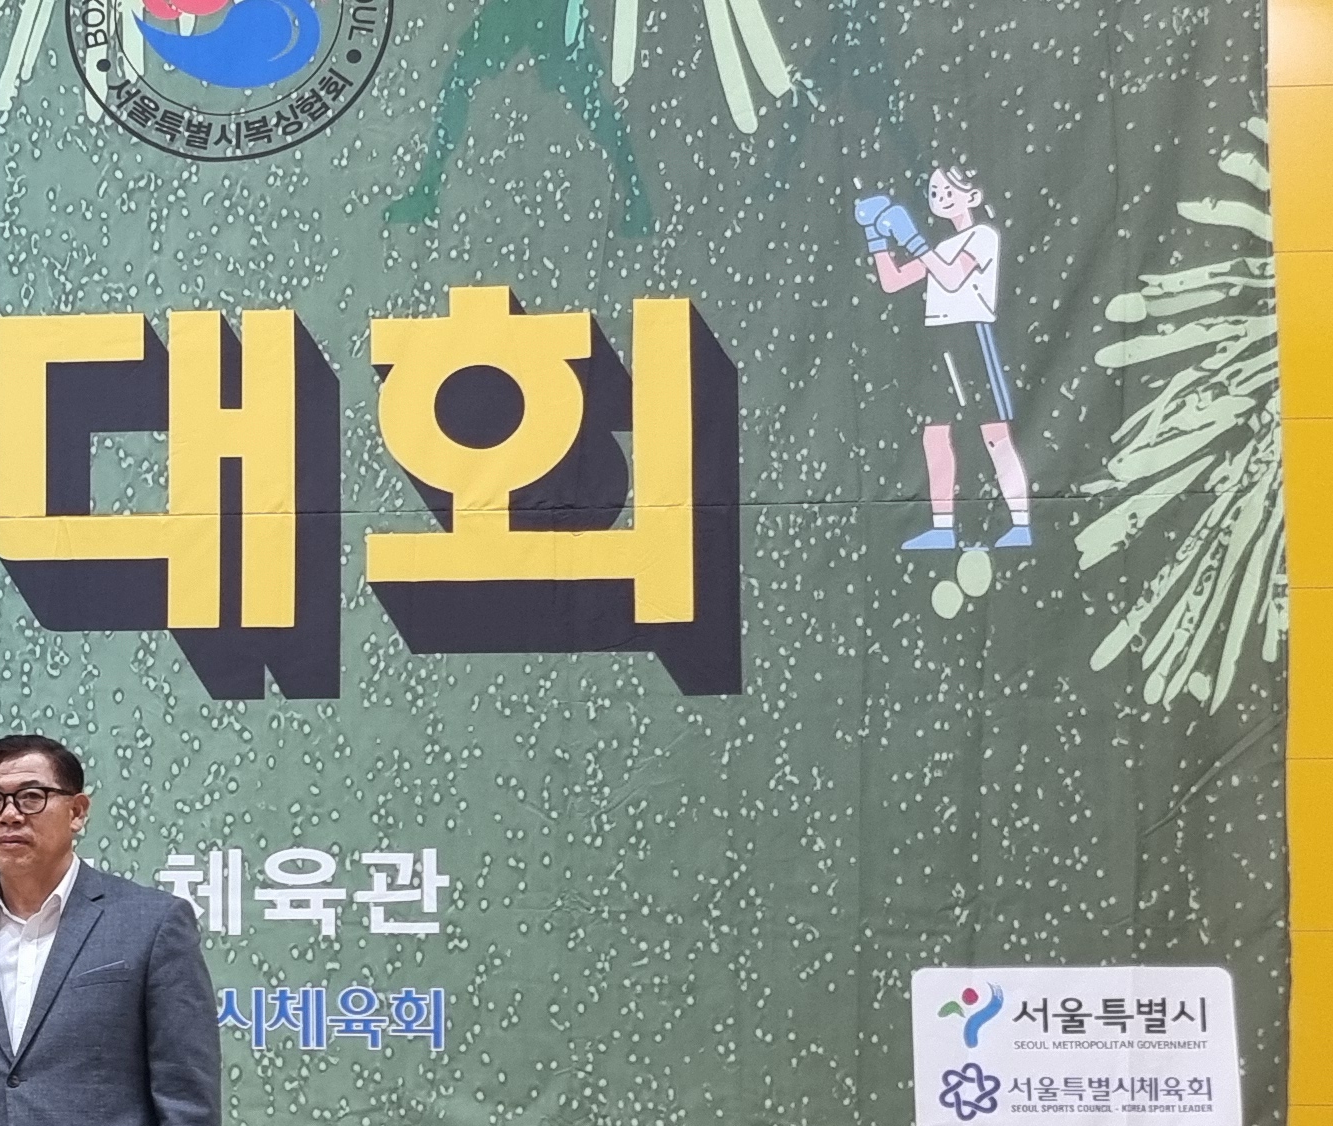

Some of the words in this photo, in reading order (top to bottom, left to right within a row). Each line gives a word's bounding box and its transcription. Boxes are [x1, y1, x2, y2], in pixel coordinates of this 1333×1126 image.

[107, 68, 354, 150] 서울특별시복싱협회
[159, 848, 450, 936] 체육관
[1012, 997, 1208, 1034] 서울특별시
[1014, 1040, 1049, 1050] SEOUL
[1052, 1040, 1134, 1050] METROPOLITAN
[1136, 1040, 1208, 1050] GOVERNMENT
[1008, 1076, 1213, 1102] 서울특별시체육회
[1011, 1104, 1039, 1113] SEOUL
[1041, 1104, 1075, 1113] SPORTS
[1077, 1104, 1113, 1113] COUNCIL
[1148, 1104, 1176, 1113] SPORT
[1178, 1104, 1213, 1113] LEADER
